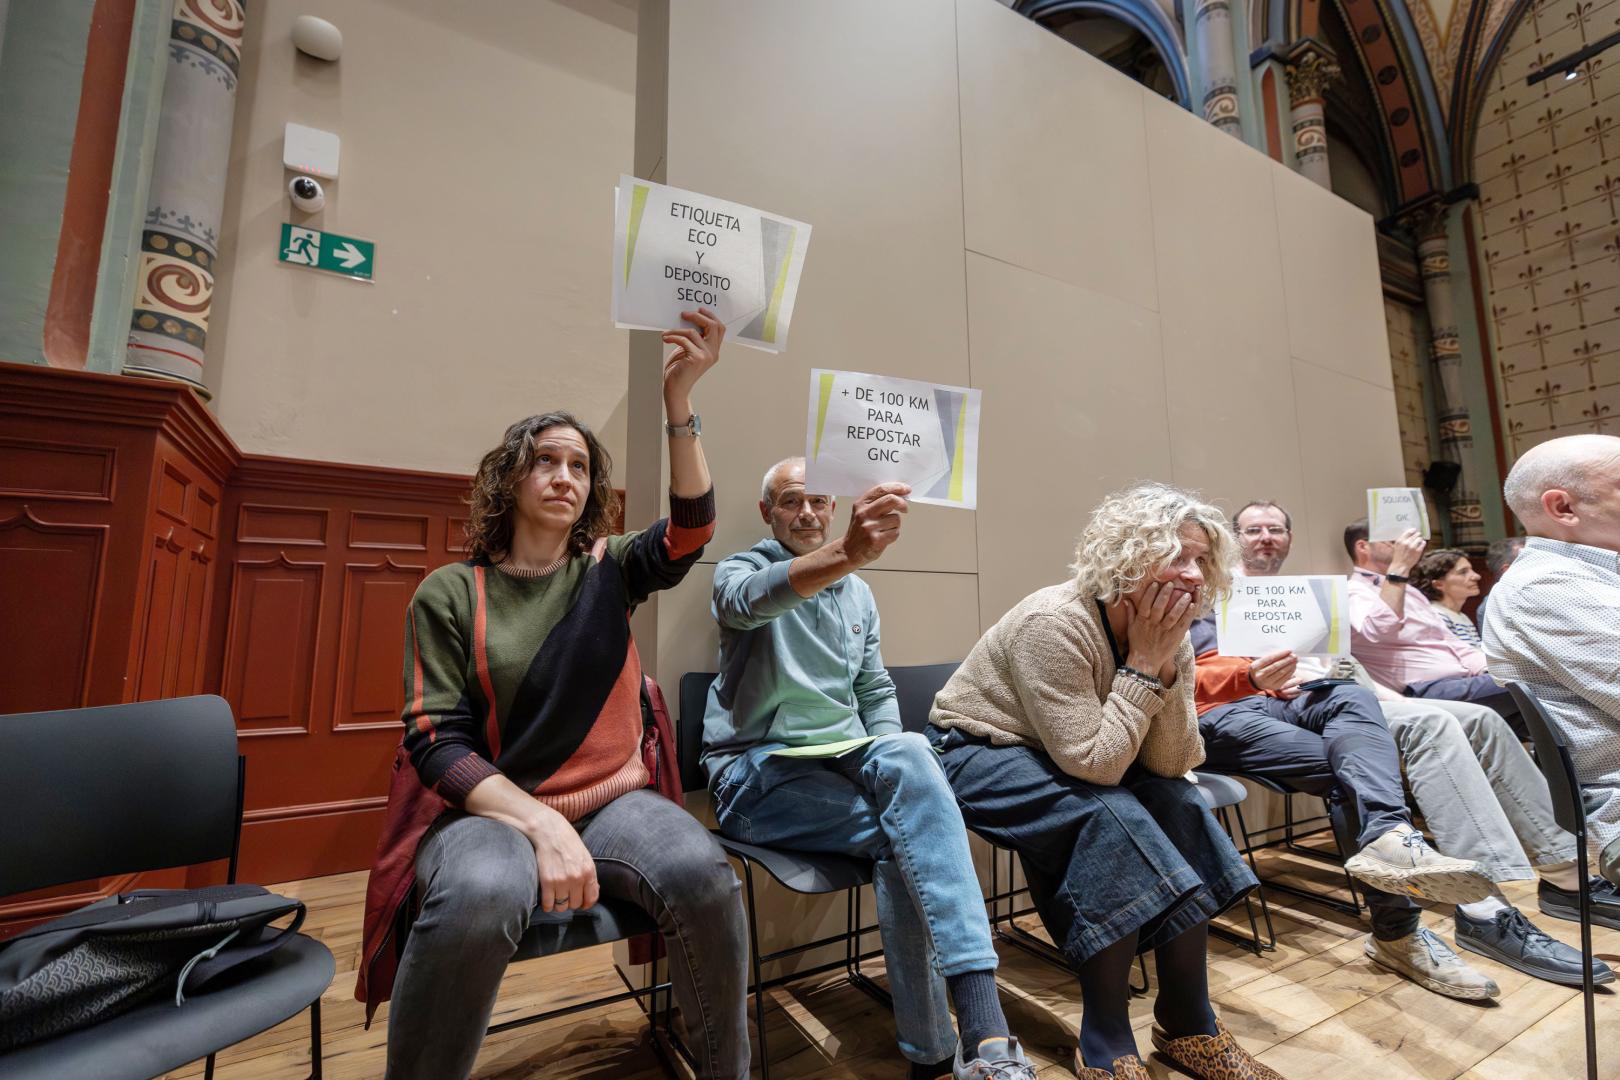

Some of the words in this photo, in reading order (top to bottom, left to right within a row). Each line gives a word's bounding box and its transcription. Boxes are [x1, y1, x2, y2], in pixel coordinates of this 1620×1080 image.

[670, 202, 741, 232] ETIQUETA
[688, 228, 717, 246] ECO
[696, 251, 704, 264] Y
[664, 265, 730, 290] DEPOSITO
[678, 288, 717, 307] SECO!
[856, 387, 874, 402] DE
[880, 392, 904, 406] 100
[909, 396, 930, 411] KM
[868, 408, 904, 426] PARA
[847, 426, 921, 447] REPOSTAR
[868, 448, 900, 463] GNC
[1246, 586, 1260, 595] DE
[1266, 586, 1285, 595] 100
[1289, 586, 1306, 594] KM
[1257, 599, 1286, 608] PARA
[1244, 612, 1302, 620] REPOSTAR
[1261, 624, 1287, 634] GNC
